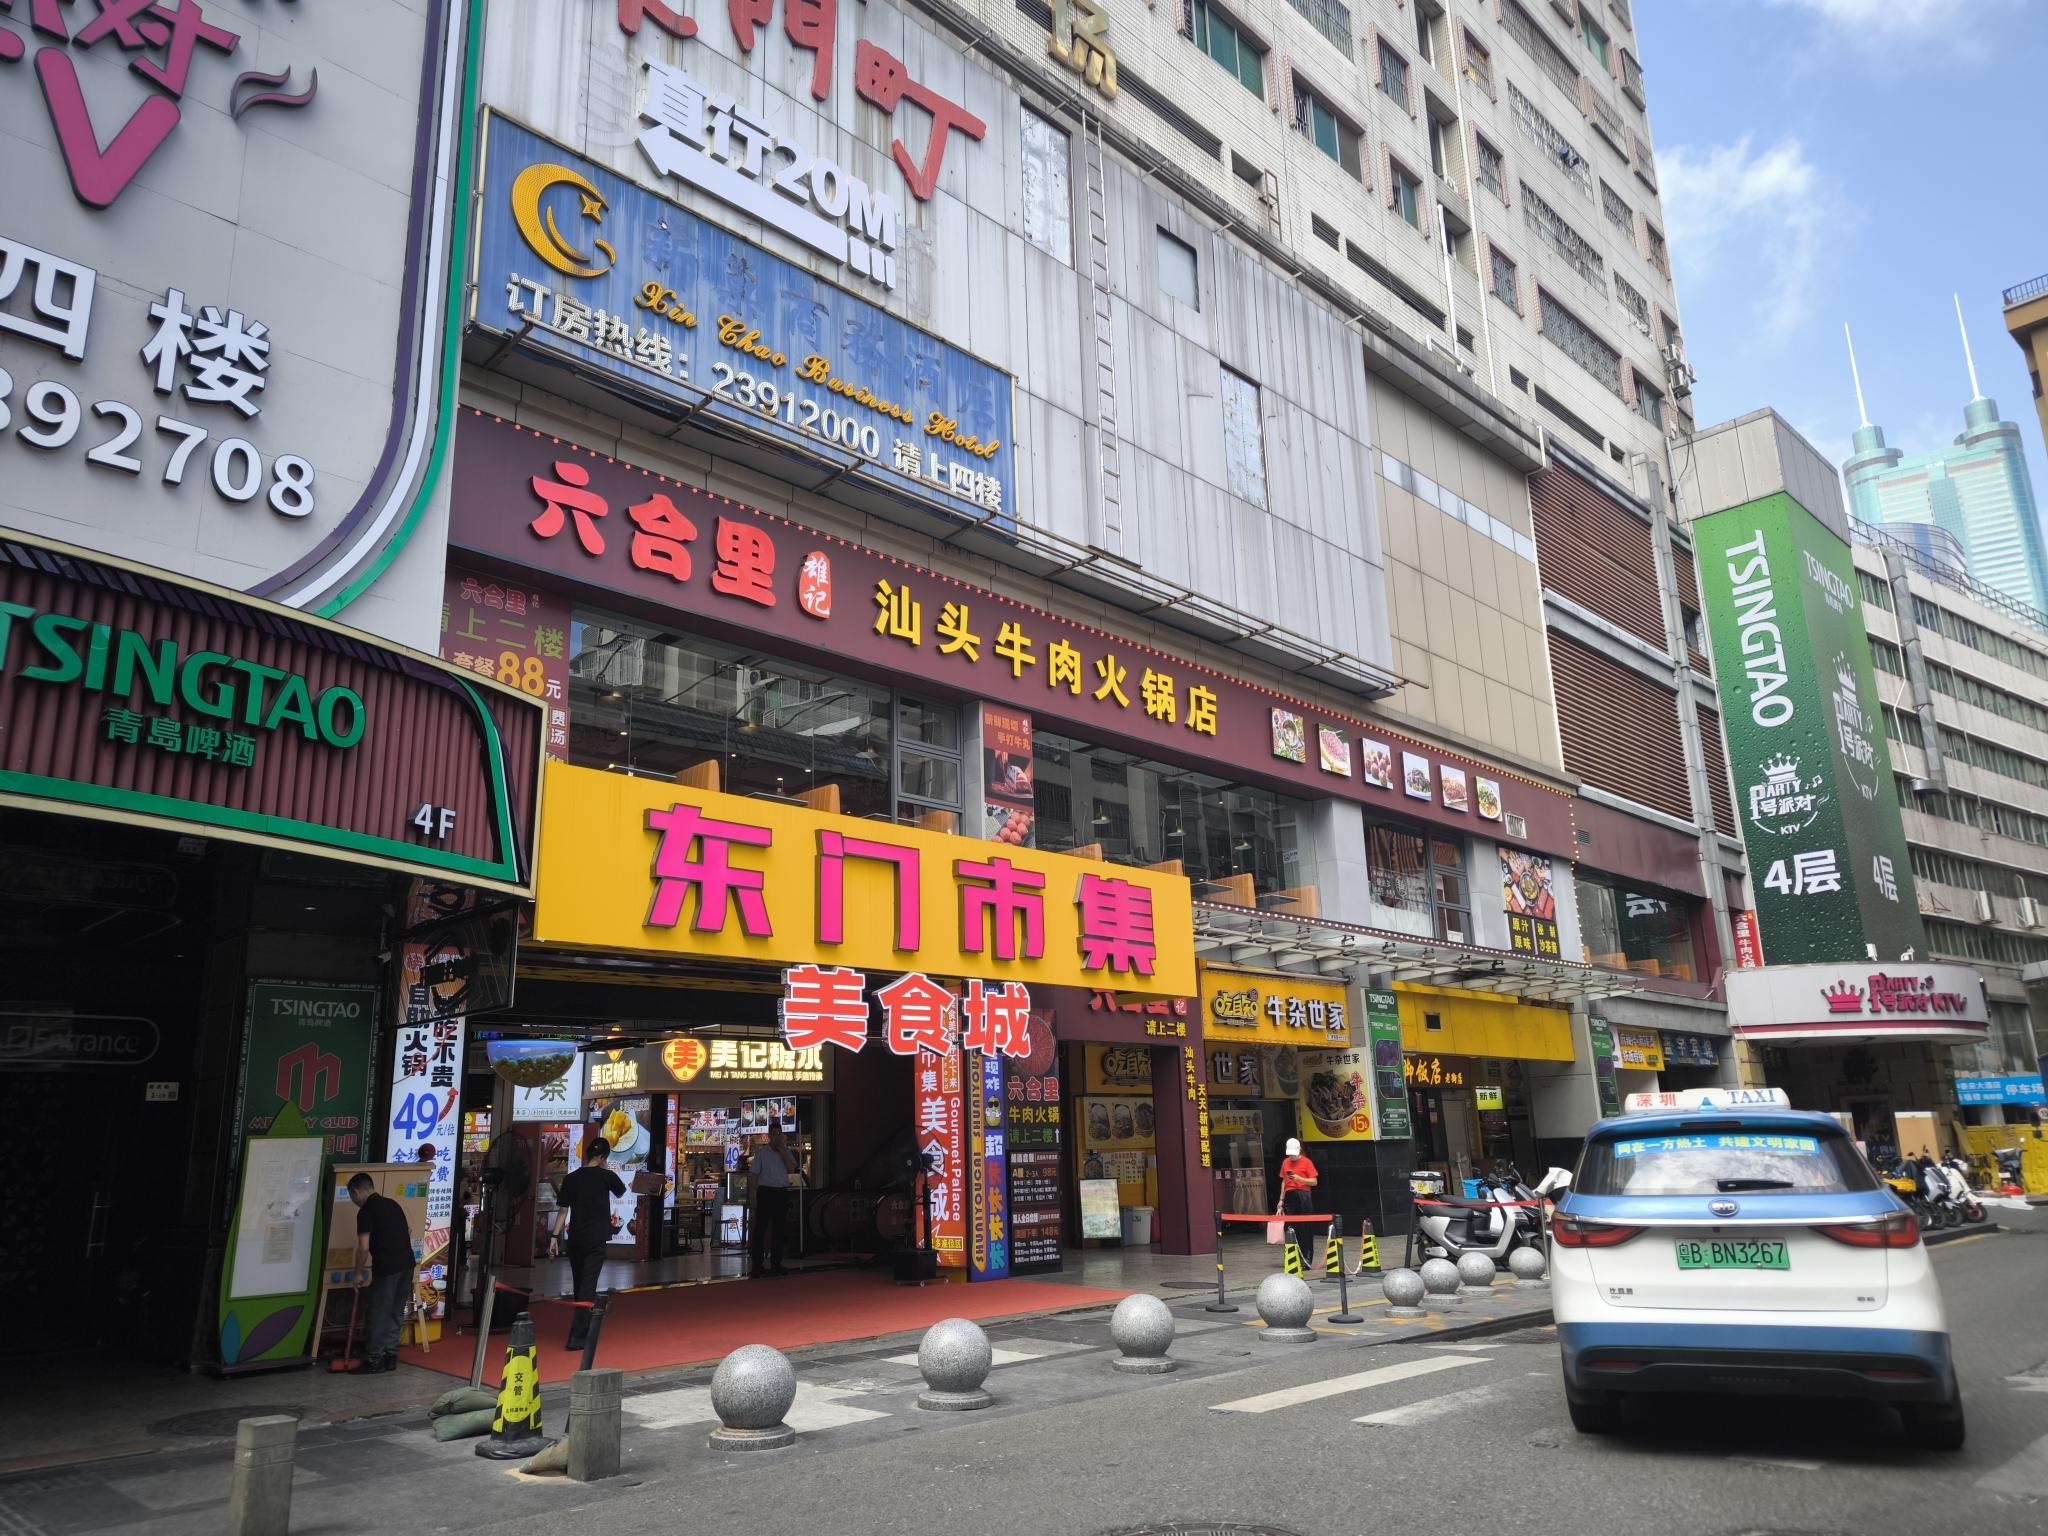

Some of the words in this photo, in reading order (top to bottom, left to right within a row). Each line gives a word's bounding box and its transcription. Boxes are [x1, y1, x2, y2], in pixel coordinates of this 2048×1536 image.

[640, 61, 896, 251] 直行20M
[795, 353, 914, 425] Business
[923, 410, 1002, 461] Hotel
[0, 367, 315, 518] 92708
[711, 361, 880, 459] 23912000
[892, 437, 1003, 510] 请上四楼
[528, 460, 777, 607] 六合里
[460, 578, 527, 615] 六合里
[1803, 550, 1854, 609] TSINGTAO
[1725, 529, 1794, 728] TSINGTAO
[872, 578, 1218, 737] 汕头牛肉火锅店
[1749, 780, 1802, 800] PARTY
[412, 803, 457, 840] 4F
[1780, 823, 1801, 835] KTV
[643, 803, 1157, 976] 东门市集
[1763, 848, 1842, 897] 4层
[1872, 855, 1900, 903] 4层
[270, 998, 360, 1019] TSINGTAO
[781, 964, 1031, 1060] 美食城
[1266, 995, 1346, 1030] 牛杂世家
[34, 1027, 139, 1053] Entrance
[1147, 1019, 1187, 1037] 请上二楼
[591, 1059, 638, 1085] 美记糖水
[710, 1040, 824, 1070] 美记糖水
[1184, 1046, 1197, 1100] 汕头牛肉
[1326, 1053, 1360, 1066] 牛杂世家
[972, 1047, 981, 1137] SHUNIYOUC
[1008, 1075, 1060, 1101] 六合里
[1635, 1093, 1678, 1108] 深圳
[1726, 1089, 1777, 1105] TAXI
[320, 1116, 359, 1129] CLUB
[393, 1092, 439, 1140] 49
[950, 1096, 962, 1165] Gourmet
[1009, 1105, 1060, 1123] 牛肉火锅
[1197, 1083, 1211, 1168] 天天新鲜配送
[392, 1146, 451, 1164] 全场吃
[950, 1168, 962, 1222] Palace
[1711, 1202, 1736, 1212] BYD
[1712, 1242, 1785, 1264] BN3267
[513, 1372, 525, 1397] 交管
